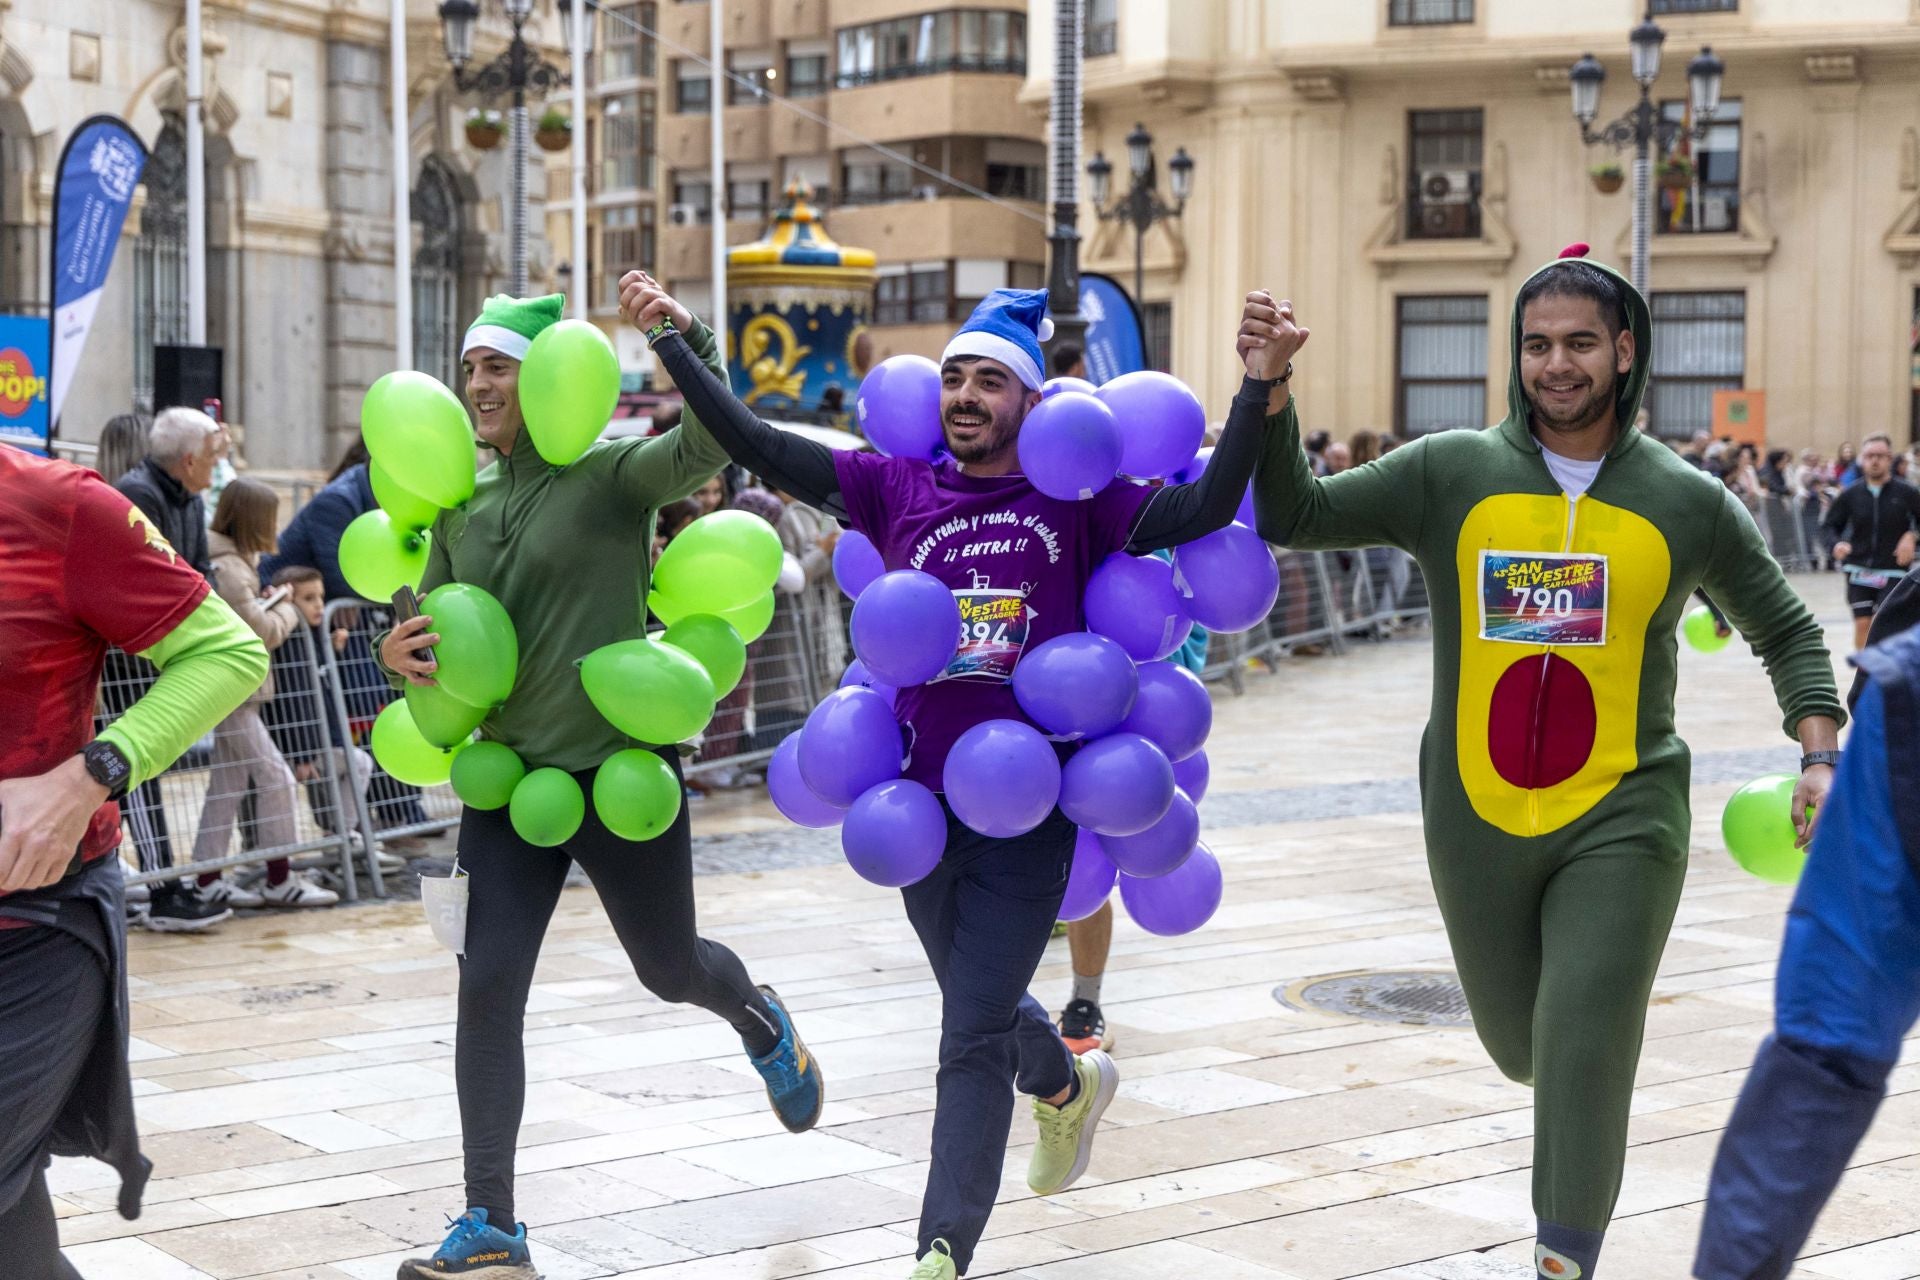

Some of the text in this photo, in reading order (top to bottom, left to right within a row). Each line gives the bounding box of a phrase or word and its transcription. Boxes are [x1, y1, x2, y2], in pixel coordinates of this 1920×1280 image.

[910, 509, 1062, 570] Entre renta y renta, el cubata
[962, 539, 1011, 557] ENTRA
[1506, 562, 1595, 590] SILVESTRE
[1507, 561, 1543, 577] SAN
[1543, 575, 1594, 590] CARTAGENA
[961, 598, 1021, 619] VESTRE
[1512, 587, 1573, 618] 790
[972, 610, 1020, 623] CARTAGENA
